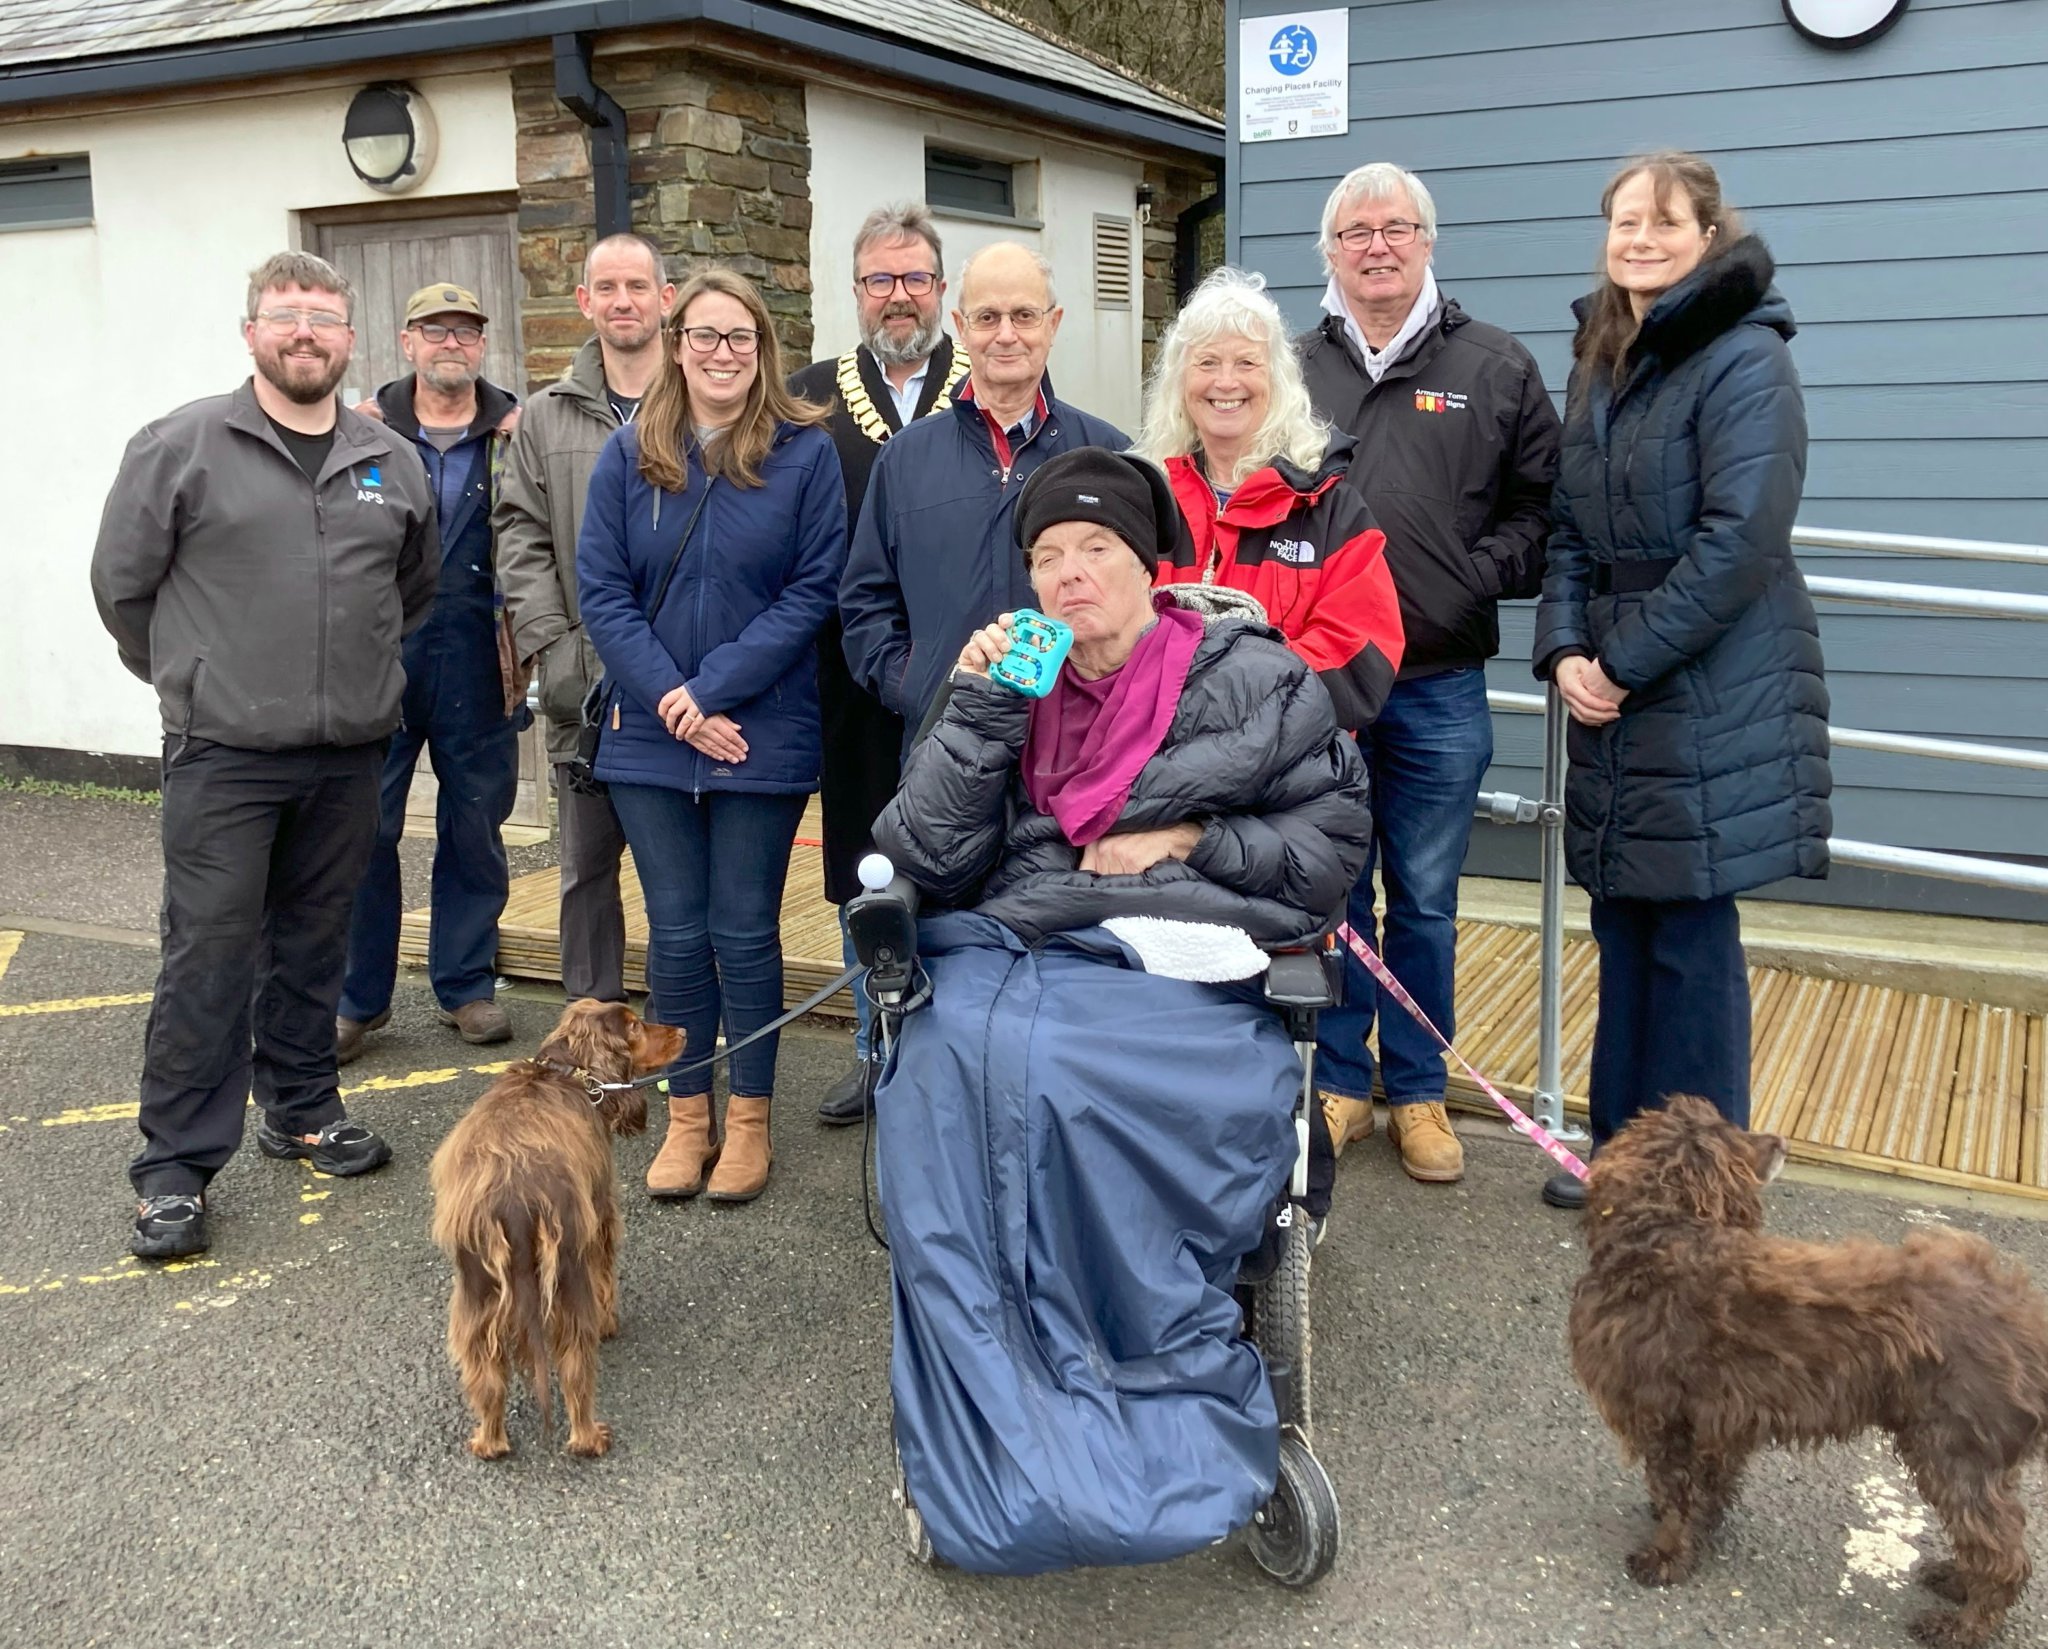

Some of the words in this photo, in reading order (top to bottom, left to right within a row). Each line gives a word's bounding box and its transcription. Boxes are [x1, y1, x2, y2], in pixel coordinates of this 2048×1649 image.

[1245, 85, 1283, 95] Changing
[1285, 82, 1311, 91] Places
[1313, 79, 1342, 88] Facility
[1415, 388, 1445, 398] Armand
[1447, 392, 1468, 400] Toms
[1446, 399, 1466, 409] Signs
[357, 489, 385, 505] APS
[1283, 538, 1299, 549] THE
[1277, 549, 1298, 562] FACE
